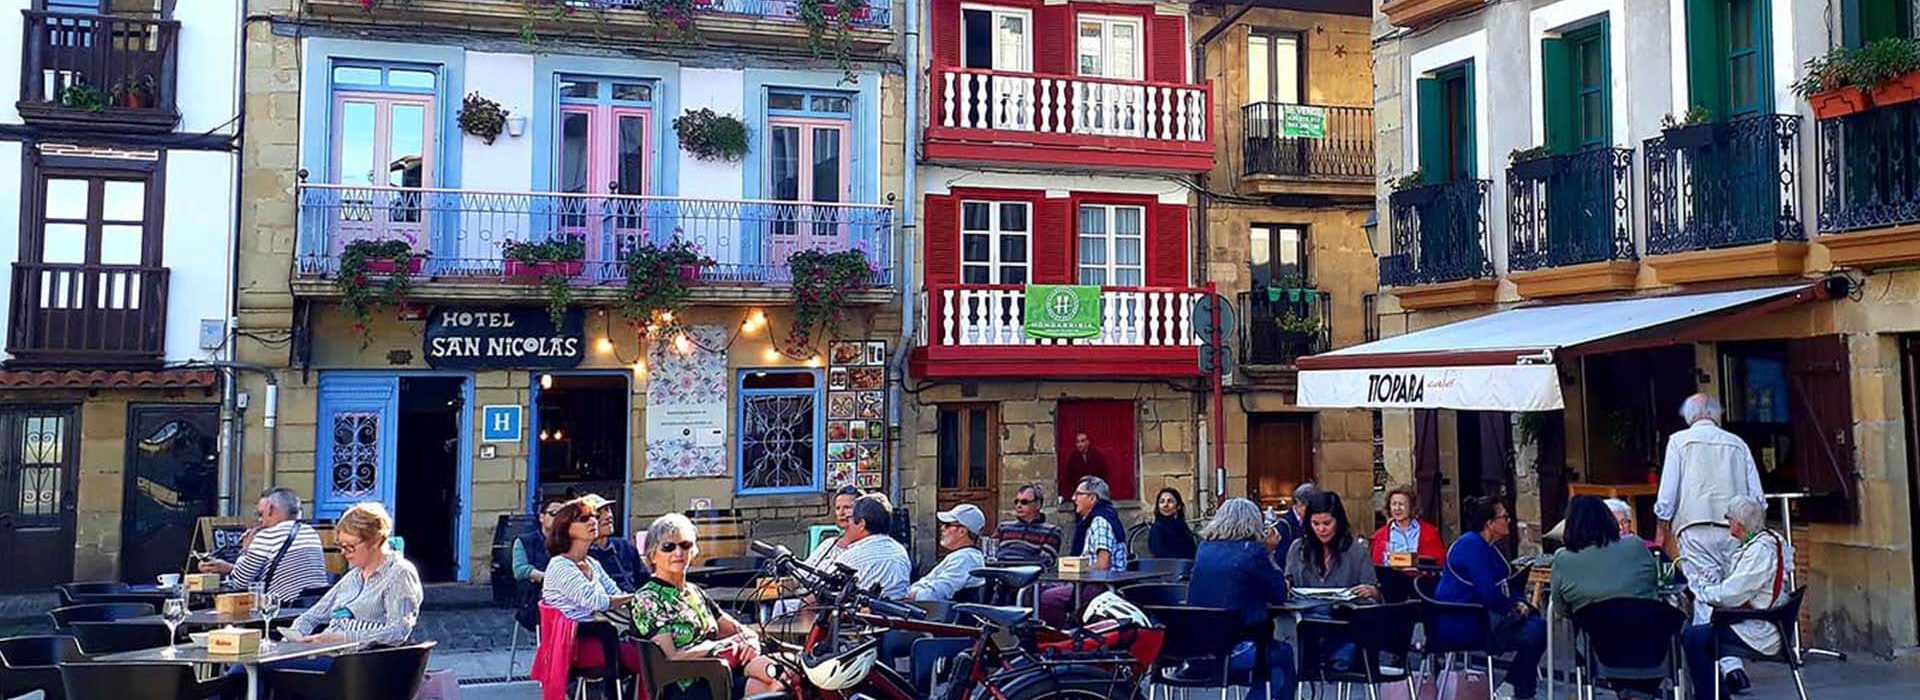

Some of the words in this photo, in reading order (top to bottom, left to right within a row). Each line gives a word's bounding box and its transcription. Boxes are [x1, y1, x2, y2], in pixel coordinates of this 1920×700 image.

[442, 312, 515, 327] HOTEL
[431, 337, 480, 357] SAN
[493, 412, 511, 432] H
